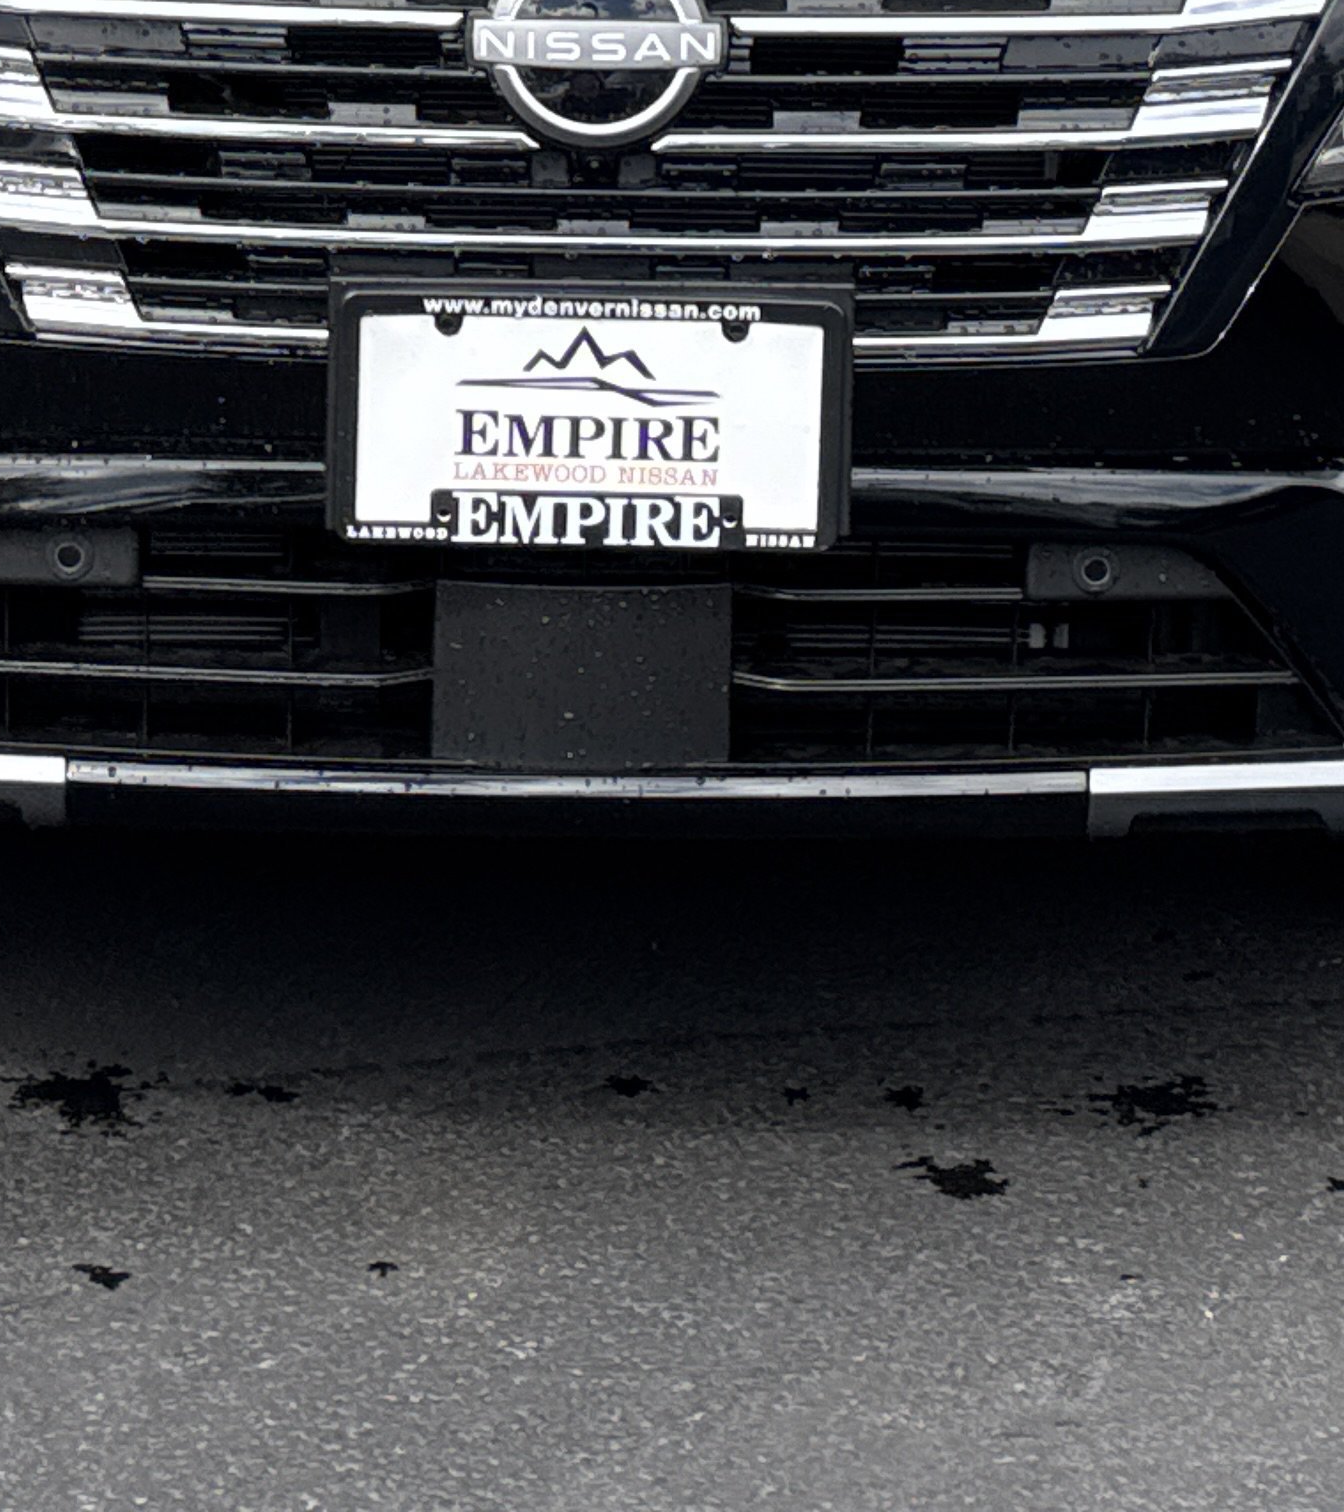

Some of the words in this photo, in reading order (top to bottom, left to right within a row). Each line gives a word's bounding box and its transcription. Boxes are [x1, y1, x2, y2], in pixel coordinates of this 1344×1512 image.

[479, 29, 716, 61] NISSAN
[423, 296, 762, 321] www.mydenvernissan.com
[454, 409, 721, 463] EMPIRE
[452, 462, 607, 484] LAKEWOOD
[618, 467, 719, 487] NISSAN
[451, 491, 721, 548] EMPIRE
